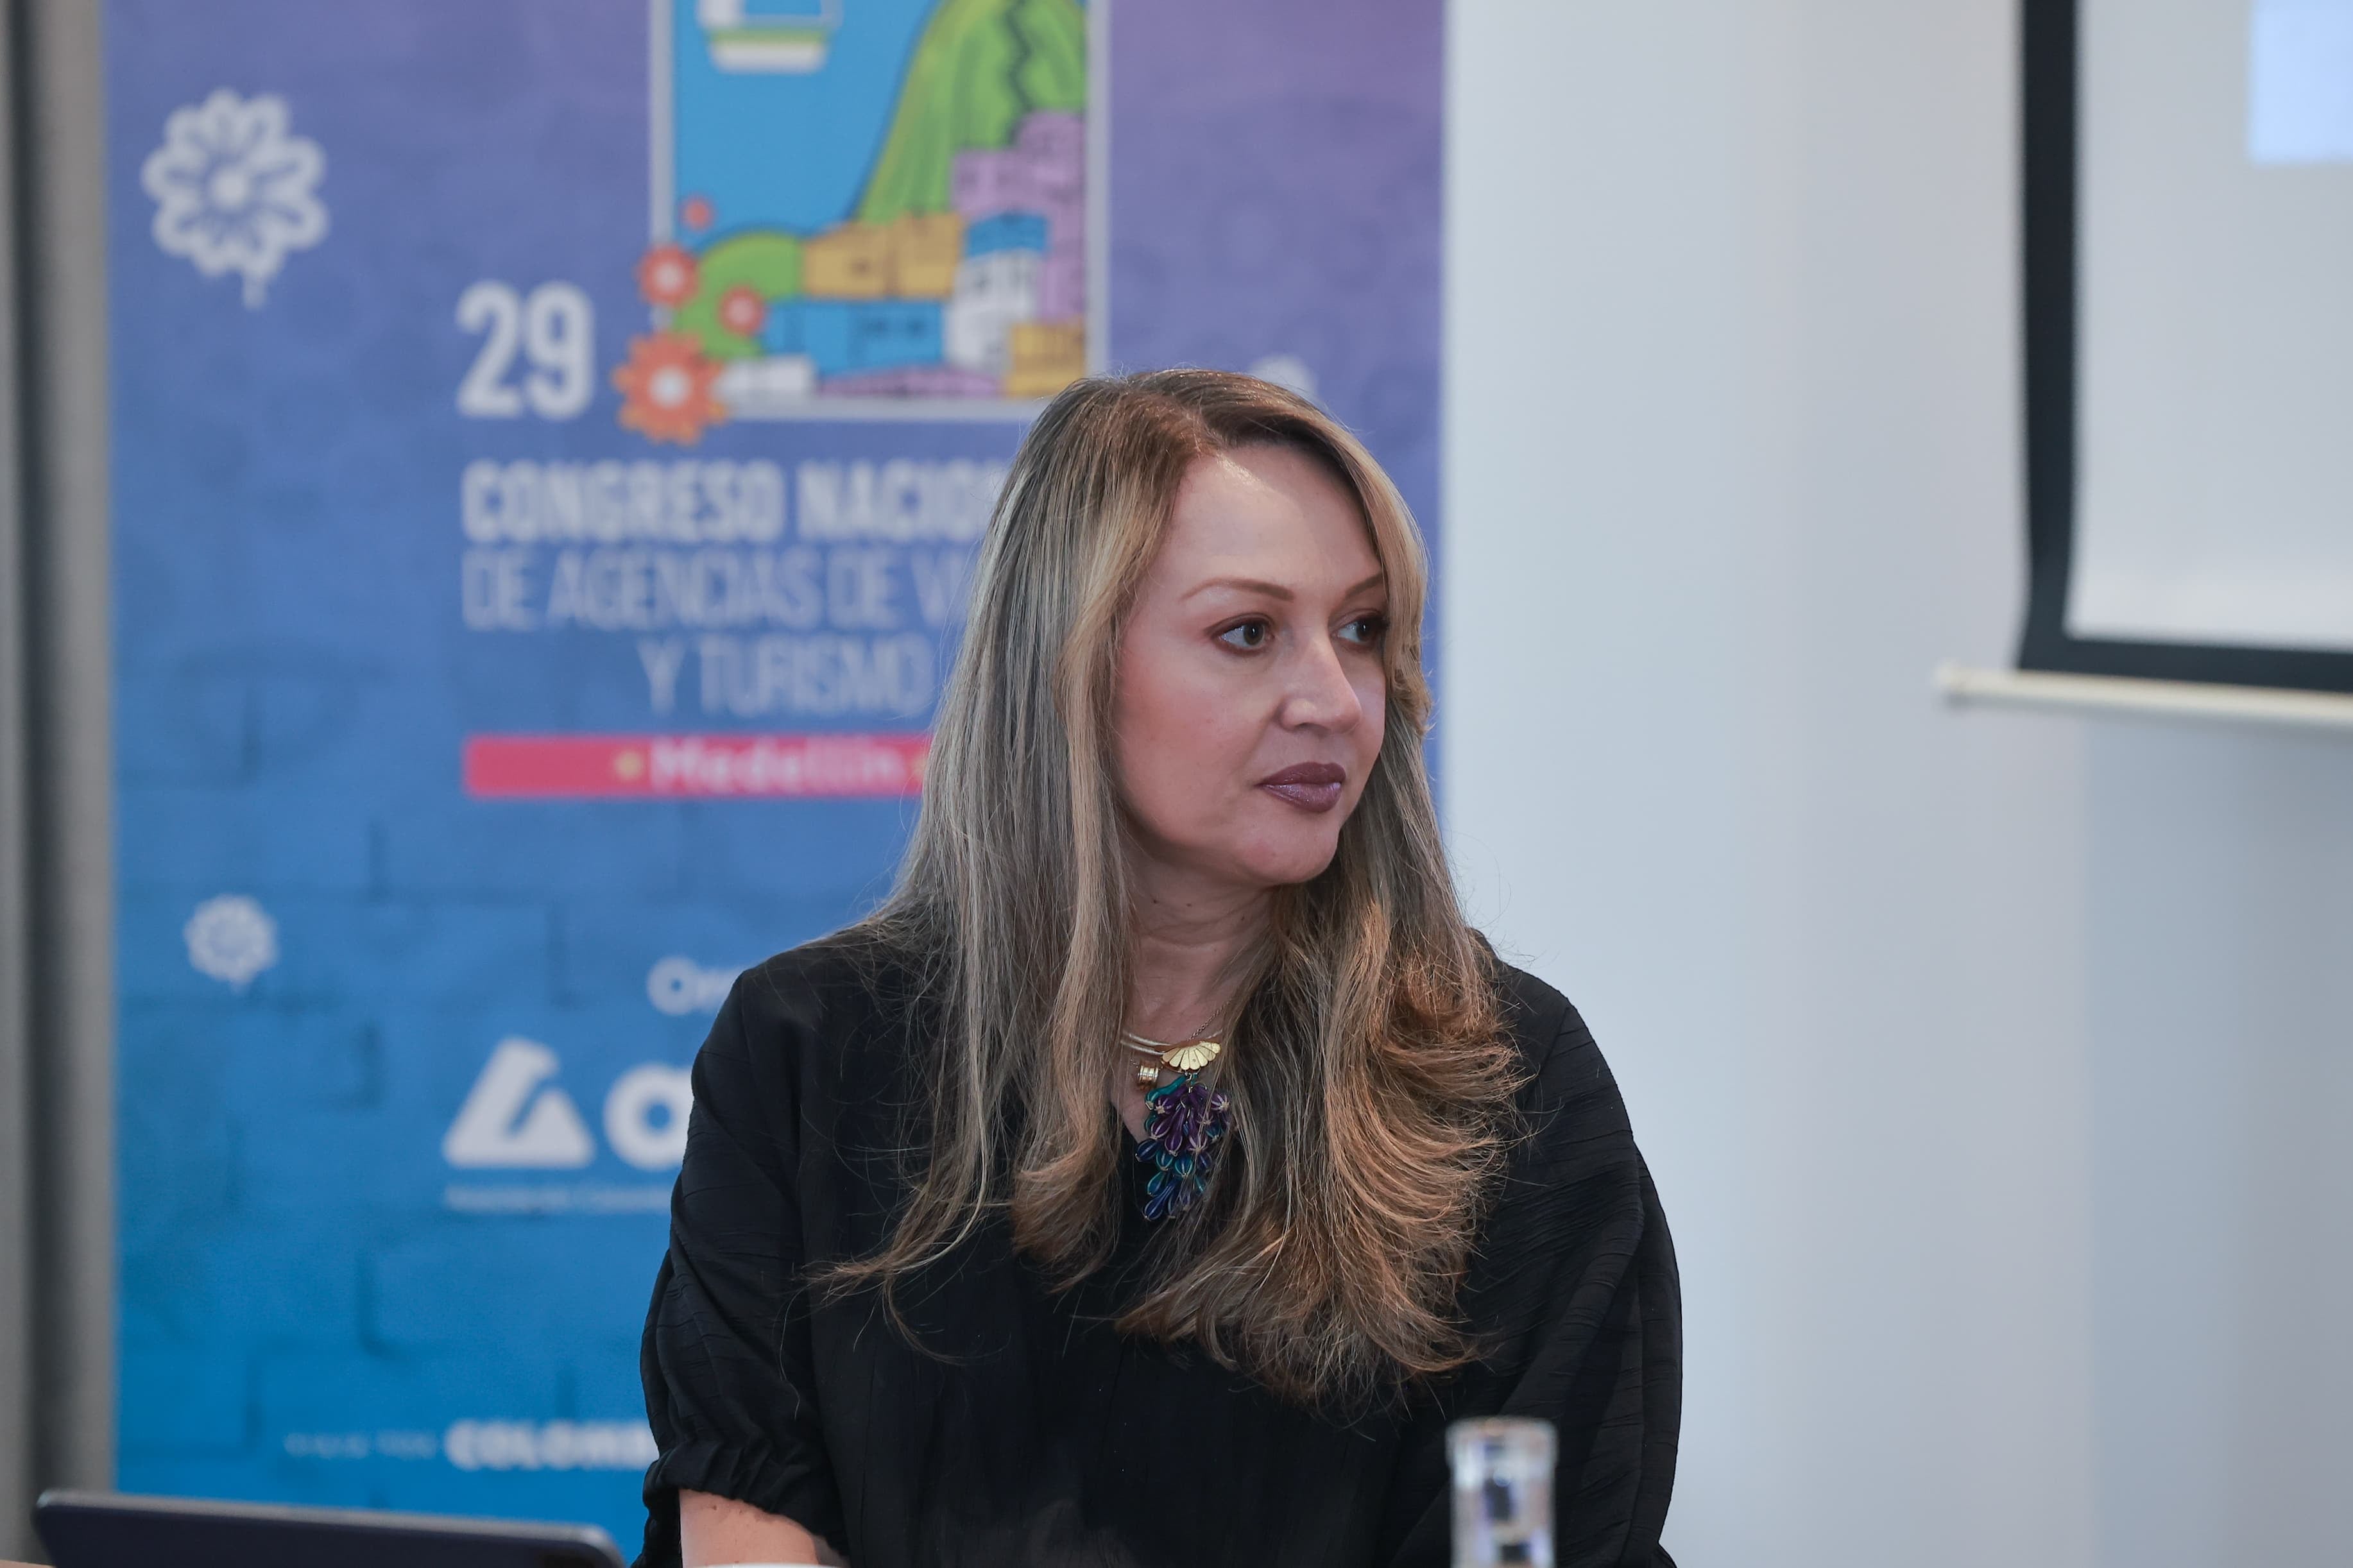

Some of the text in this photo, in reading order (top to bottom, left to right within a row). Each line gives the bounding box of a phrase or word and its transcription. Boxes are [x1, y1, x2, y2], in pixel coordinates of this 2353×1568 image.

[456, 284, 595, 418] 29
[461, 460, 783, 543] CONGRESO
[461, 550, 534, 629] DE
[548, 549, 823, 630] AGENCIAS
[828, 550, 898, 629] DE
[639, 636, 934, 716] Y TURISMO
